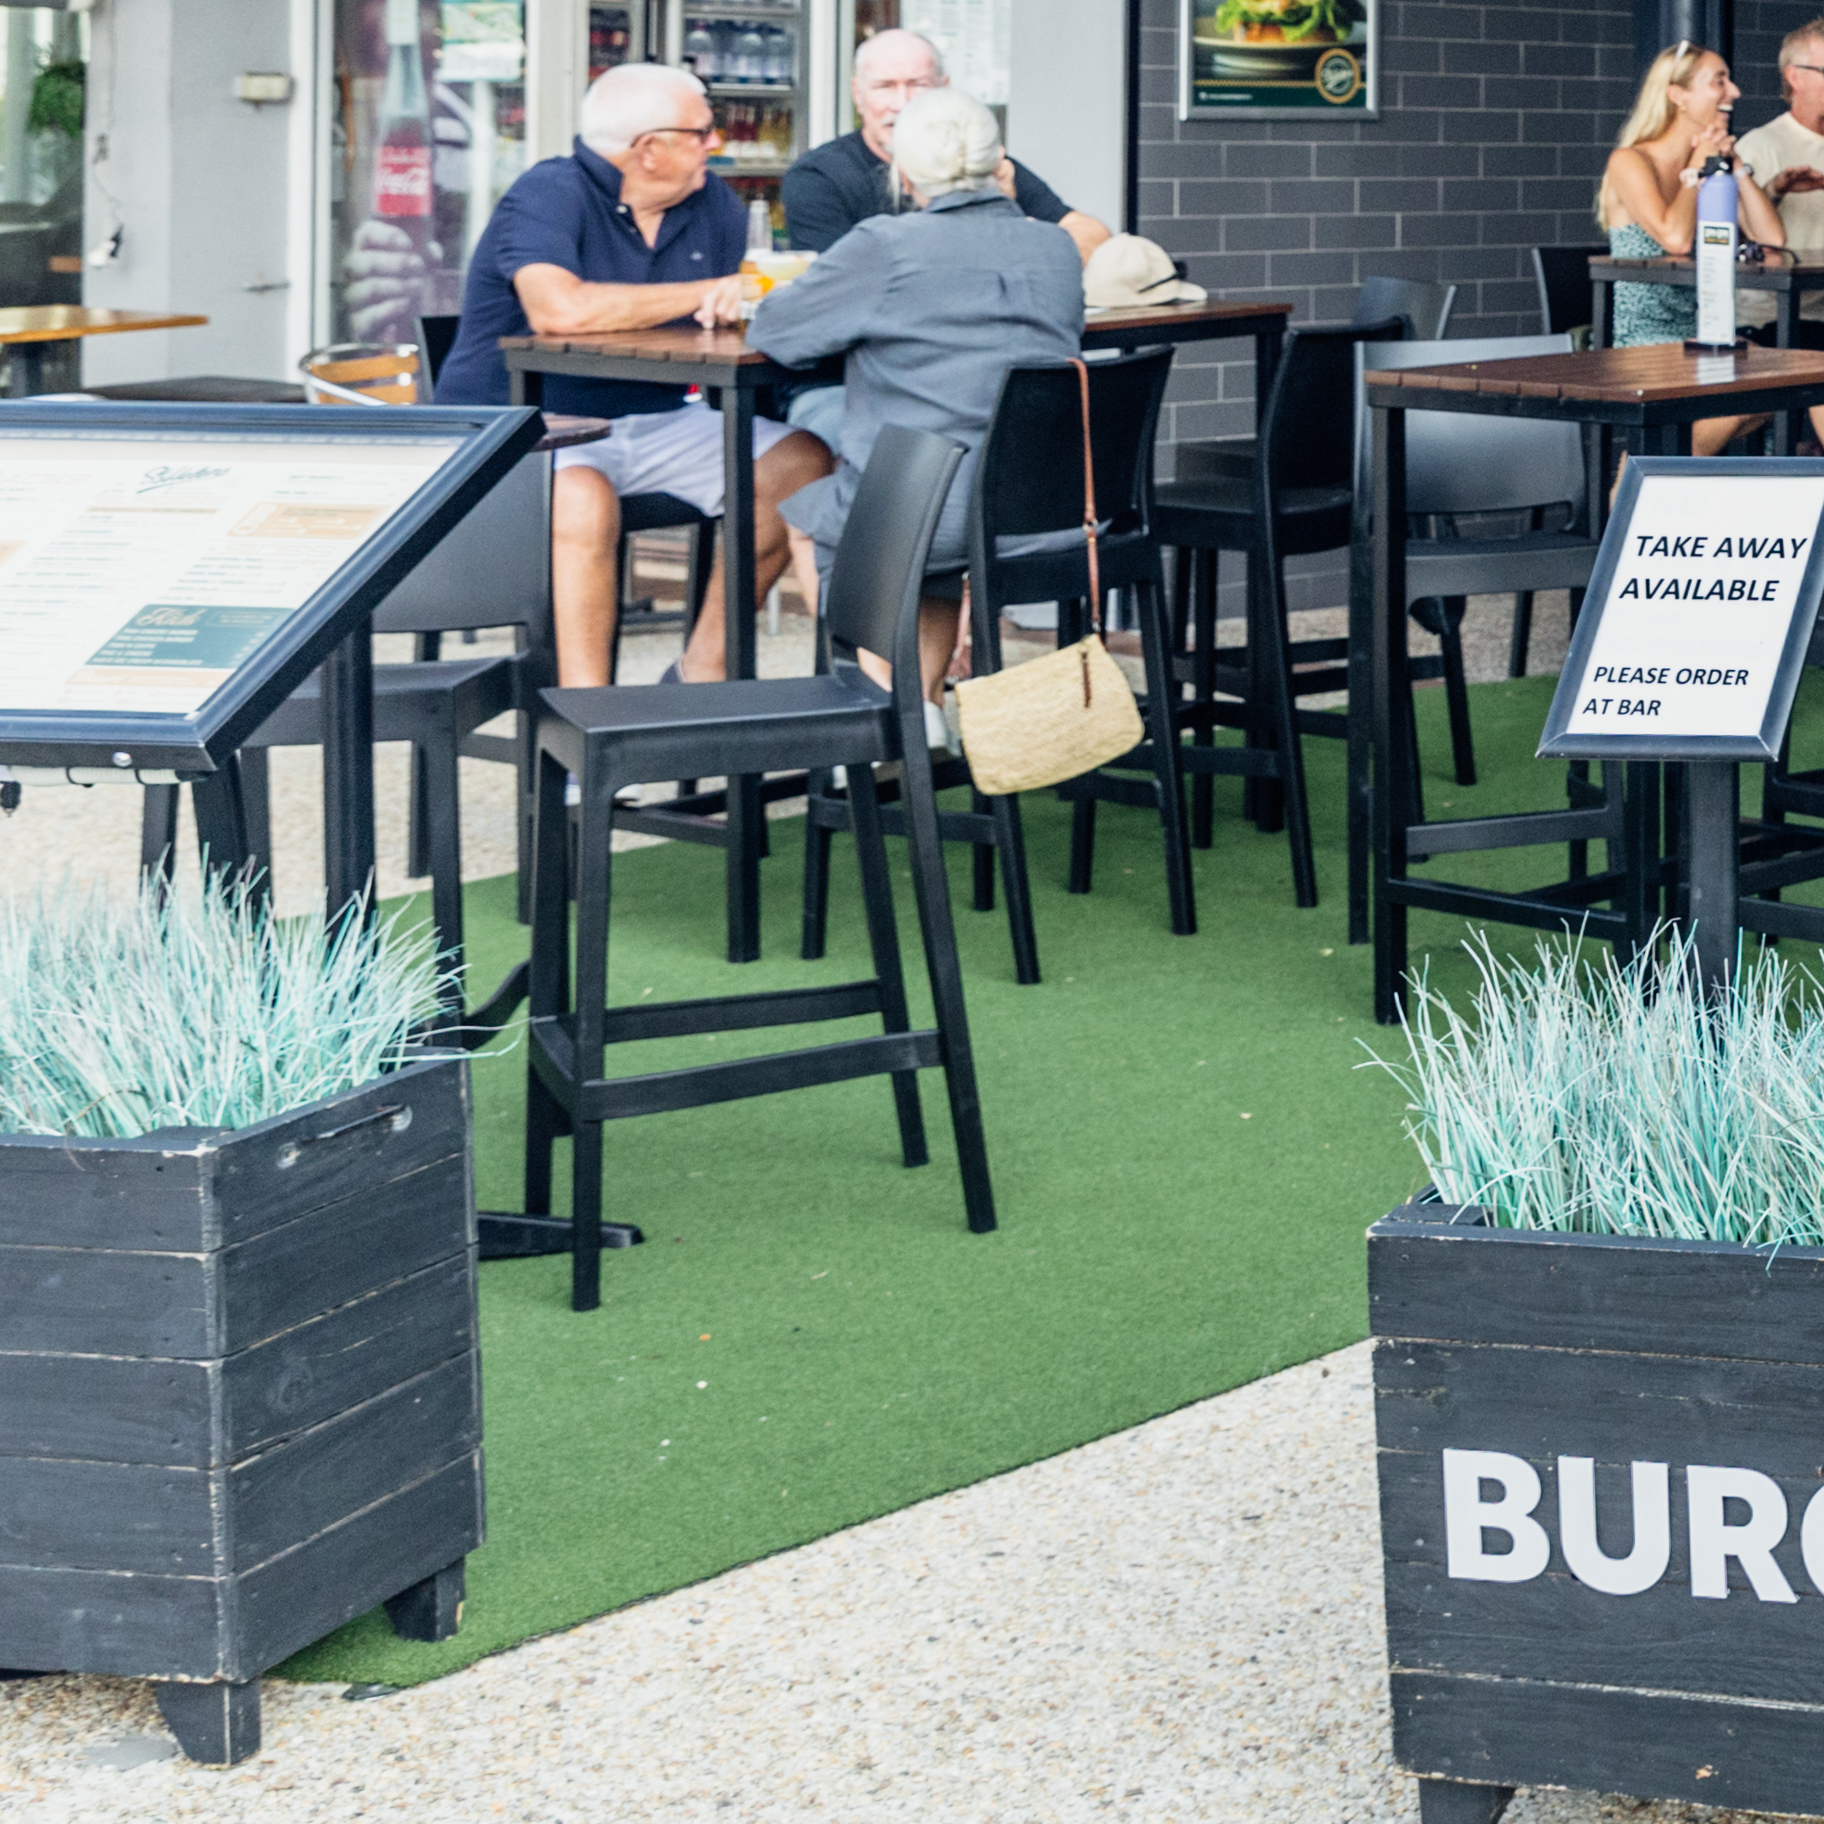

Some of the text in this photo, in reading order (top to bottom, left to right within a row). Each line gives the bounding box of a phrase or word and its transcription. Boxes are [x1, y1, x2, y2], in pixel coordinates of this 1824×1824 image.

[1636, 535, 1808, 559] TAKE AWAY
[1619, 578, 1780, 602] AVAILABLE
[1593, 666, 1750, 686] PLEASE ORDER
[1582, 698, 1662, 717] AT BAR
